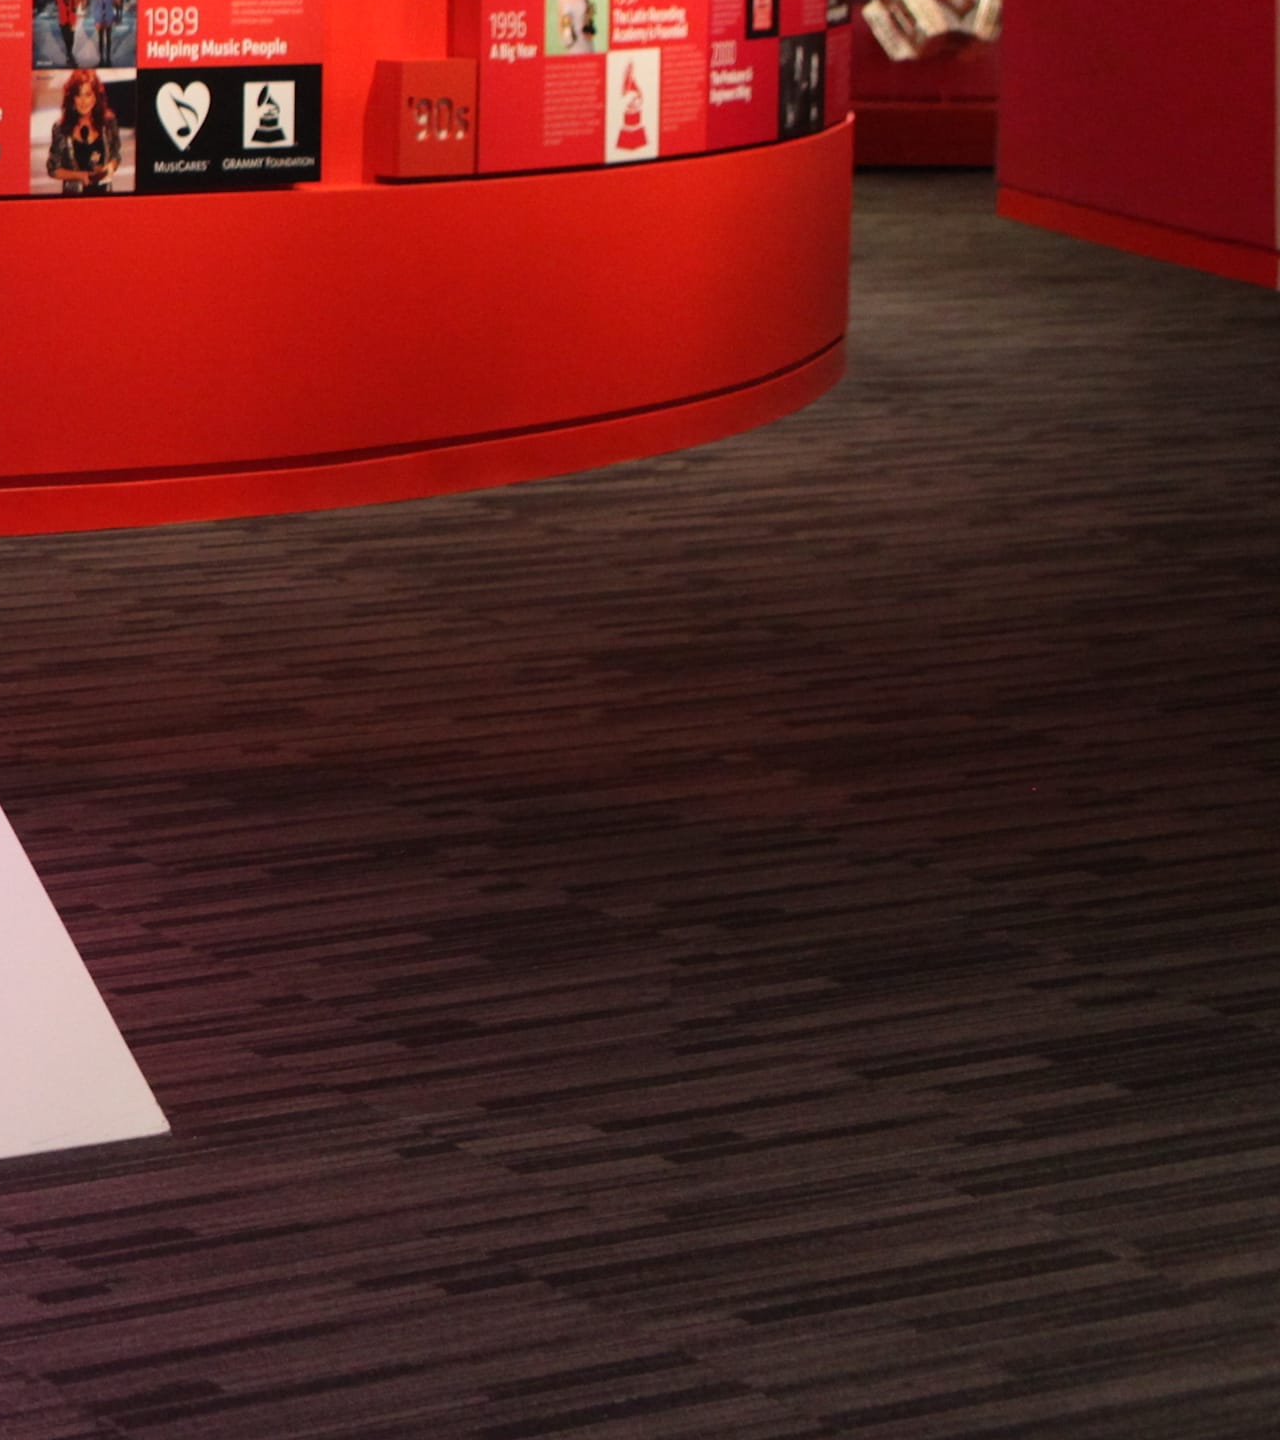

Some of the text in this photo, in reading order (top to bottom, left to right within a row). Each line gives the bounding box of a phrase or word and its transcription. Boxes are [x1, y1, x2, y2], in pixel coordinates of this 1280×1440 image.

[144, 7, 199, 36] 1989
[489, 11, 528, 39] 1996
[147, 38, 288, 61] Helping Music People
